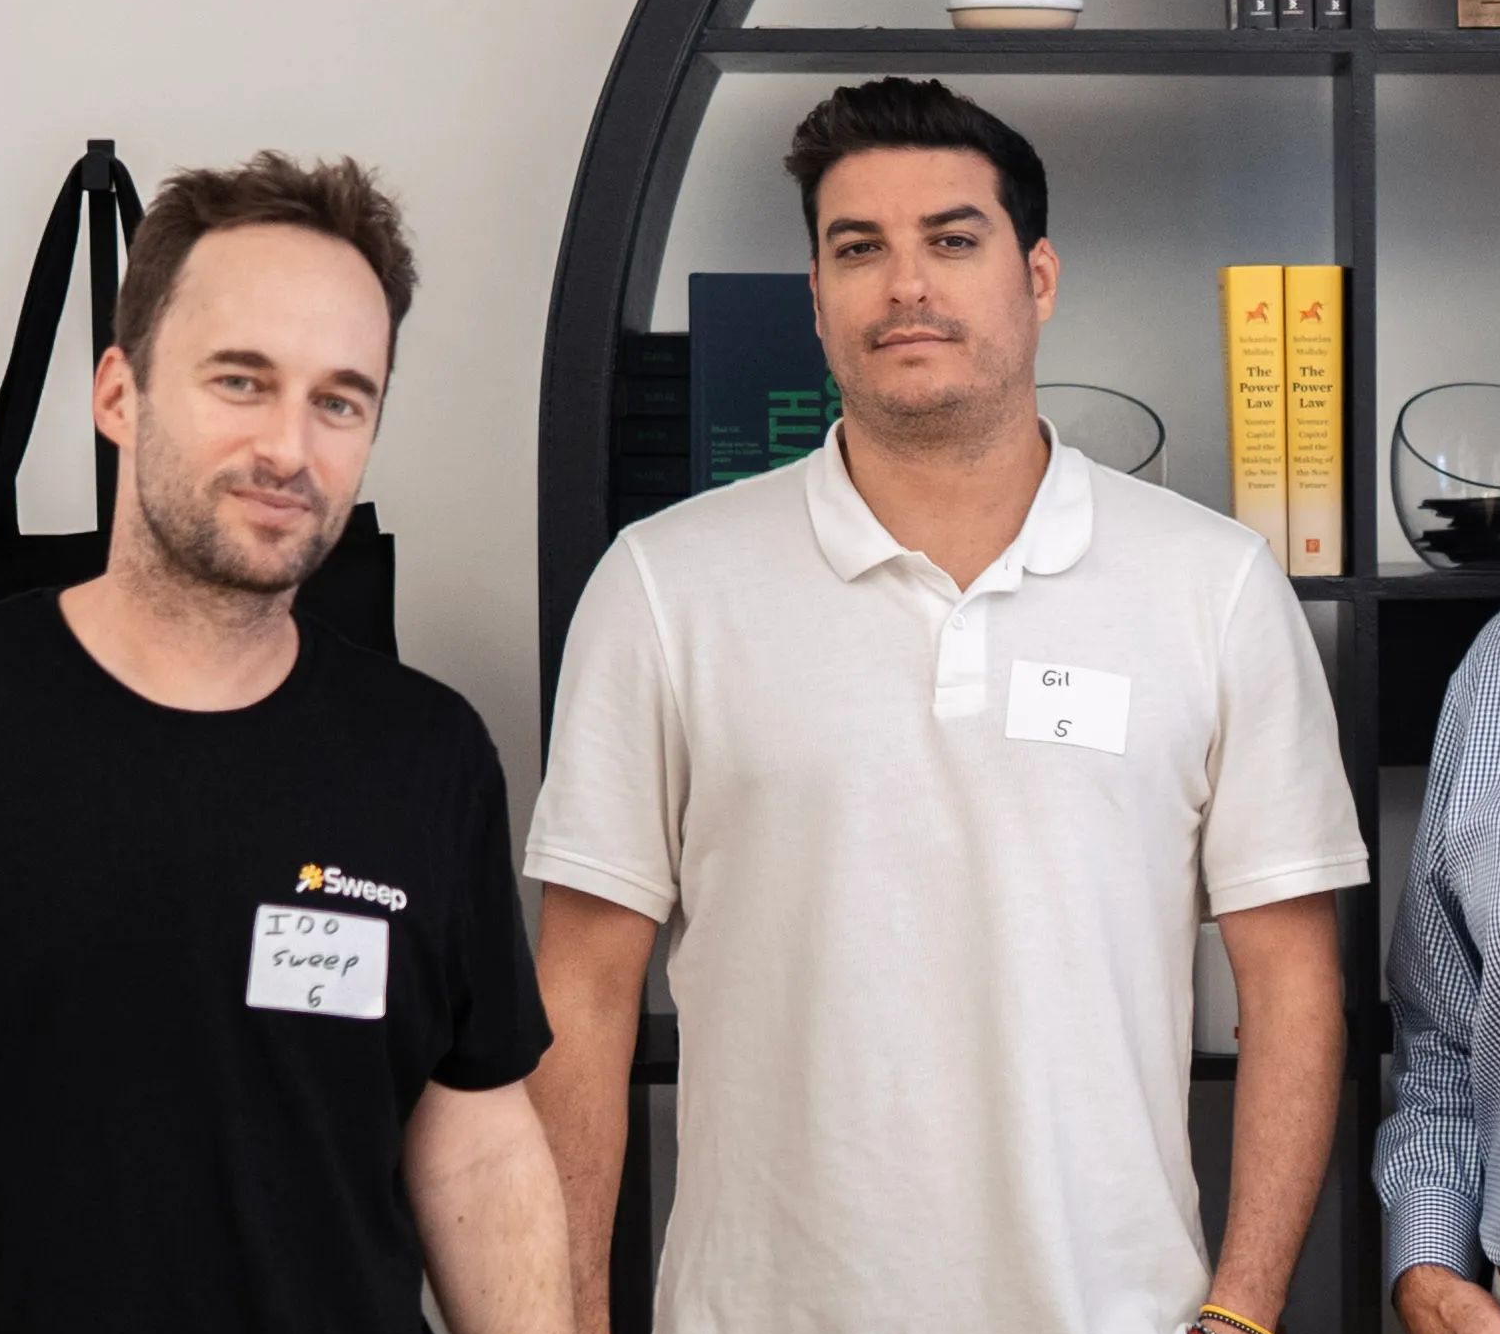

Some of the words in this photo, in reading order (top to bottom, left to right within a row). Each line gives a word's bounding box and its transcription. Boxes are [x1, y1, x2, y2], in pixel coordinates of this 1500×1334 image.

[1246, 365, 1272, 377] The
[1299, 365, 1325, 377] The
[1239, 382, 1280, 393] Power
[1292, 382, 1334, 393] Power
[1247, 398, 1274, 409] Law
[1299, 398, 1326, 408] Law
[1042, 669, 1070, 687] Gil
[323, 867, 408, 912] Sweep
[306, 984, 326, 1008] 6
